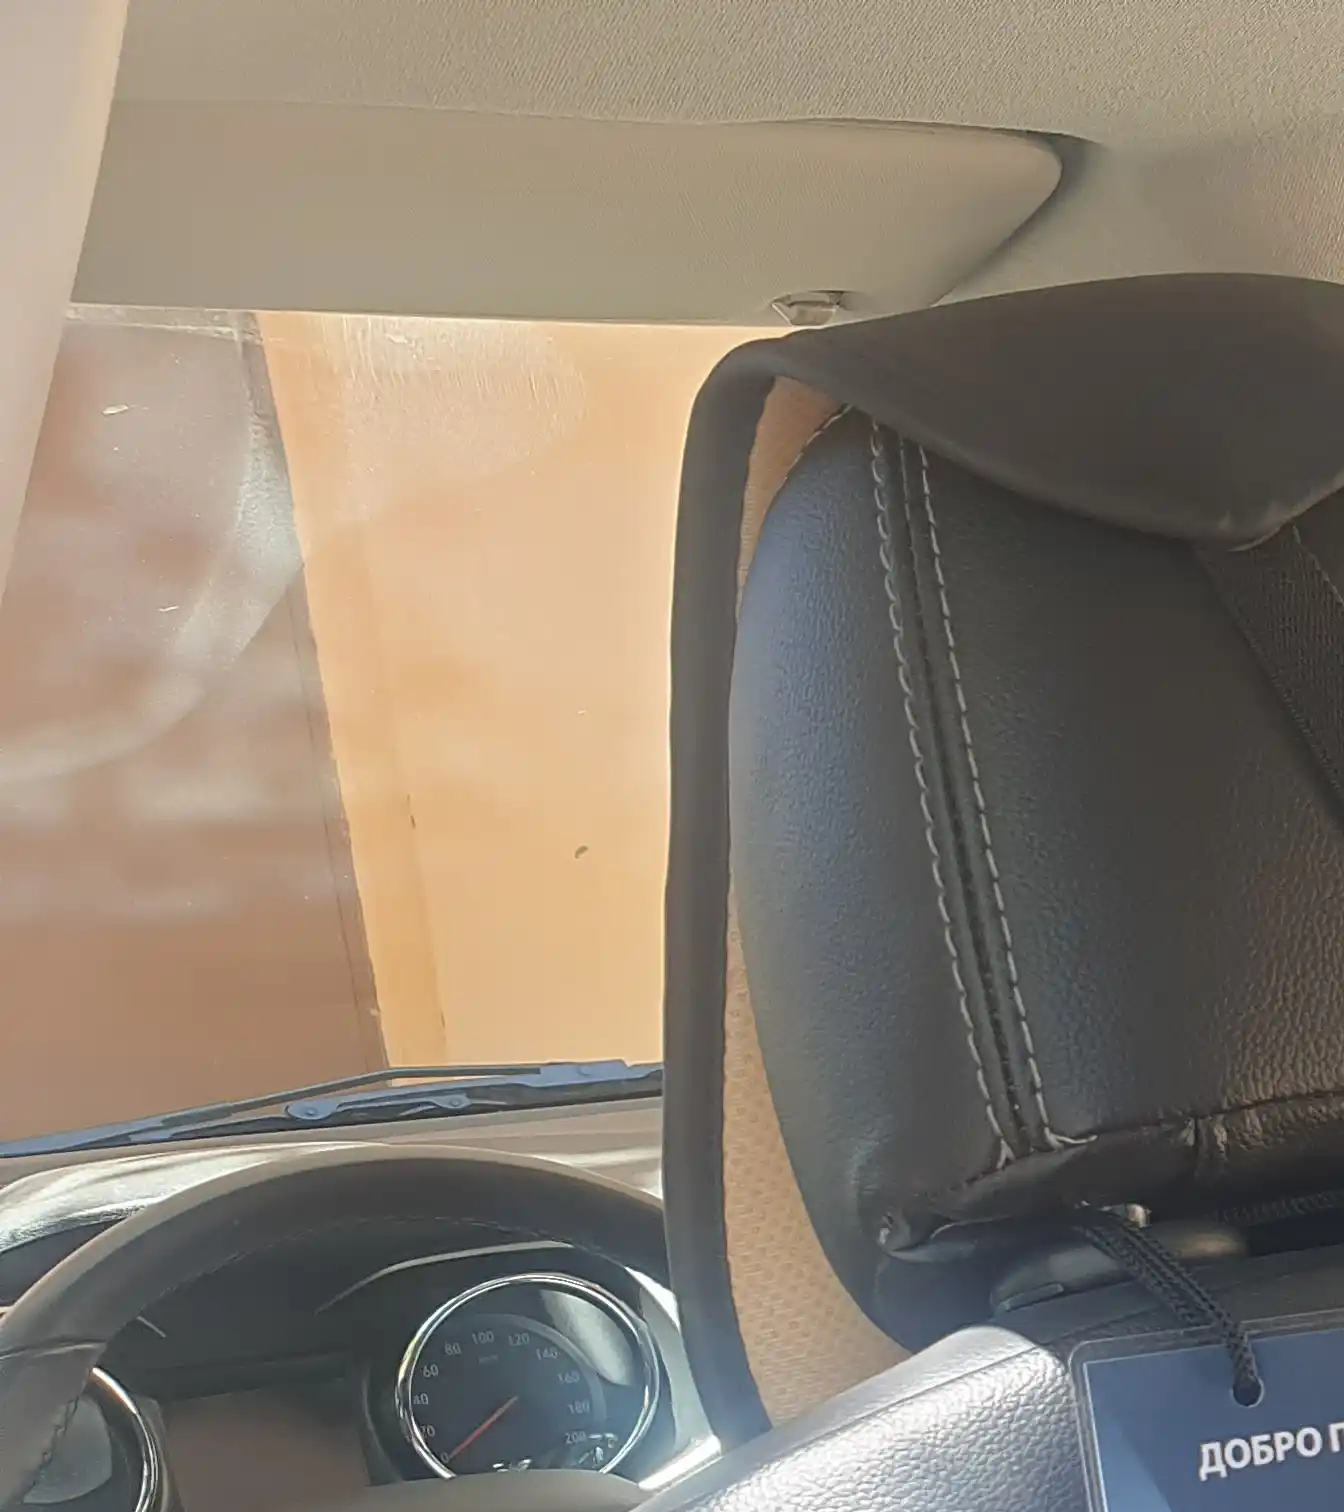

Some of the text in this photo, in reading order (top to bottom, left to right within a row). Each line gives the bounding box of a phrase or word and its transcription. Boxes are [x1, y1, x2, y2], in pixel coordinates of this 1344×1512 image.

[472, 1331, 494, 1344] 100
[508, 1333, 529, 1346] 120
[445, 1343, 461, 1355] 80
[423, 1364, 438, 1378] 60
[1199, 1427, 1321, 1481] ДОБРО
